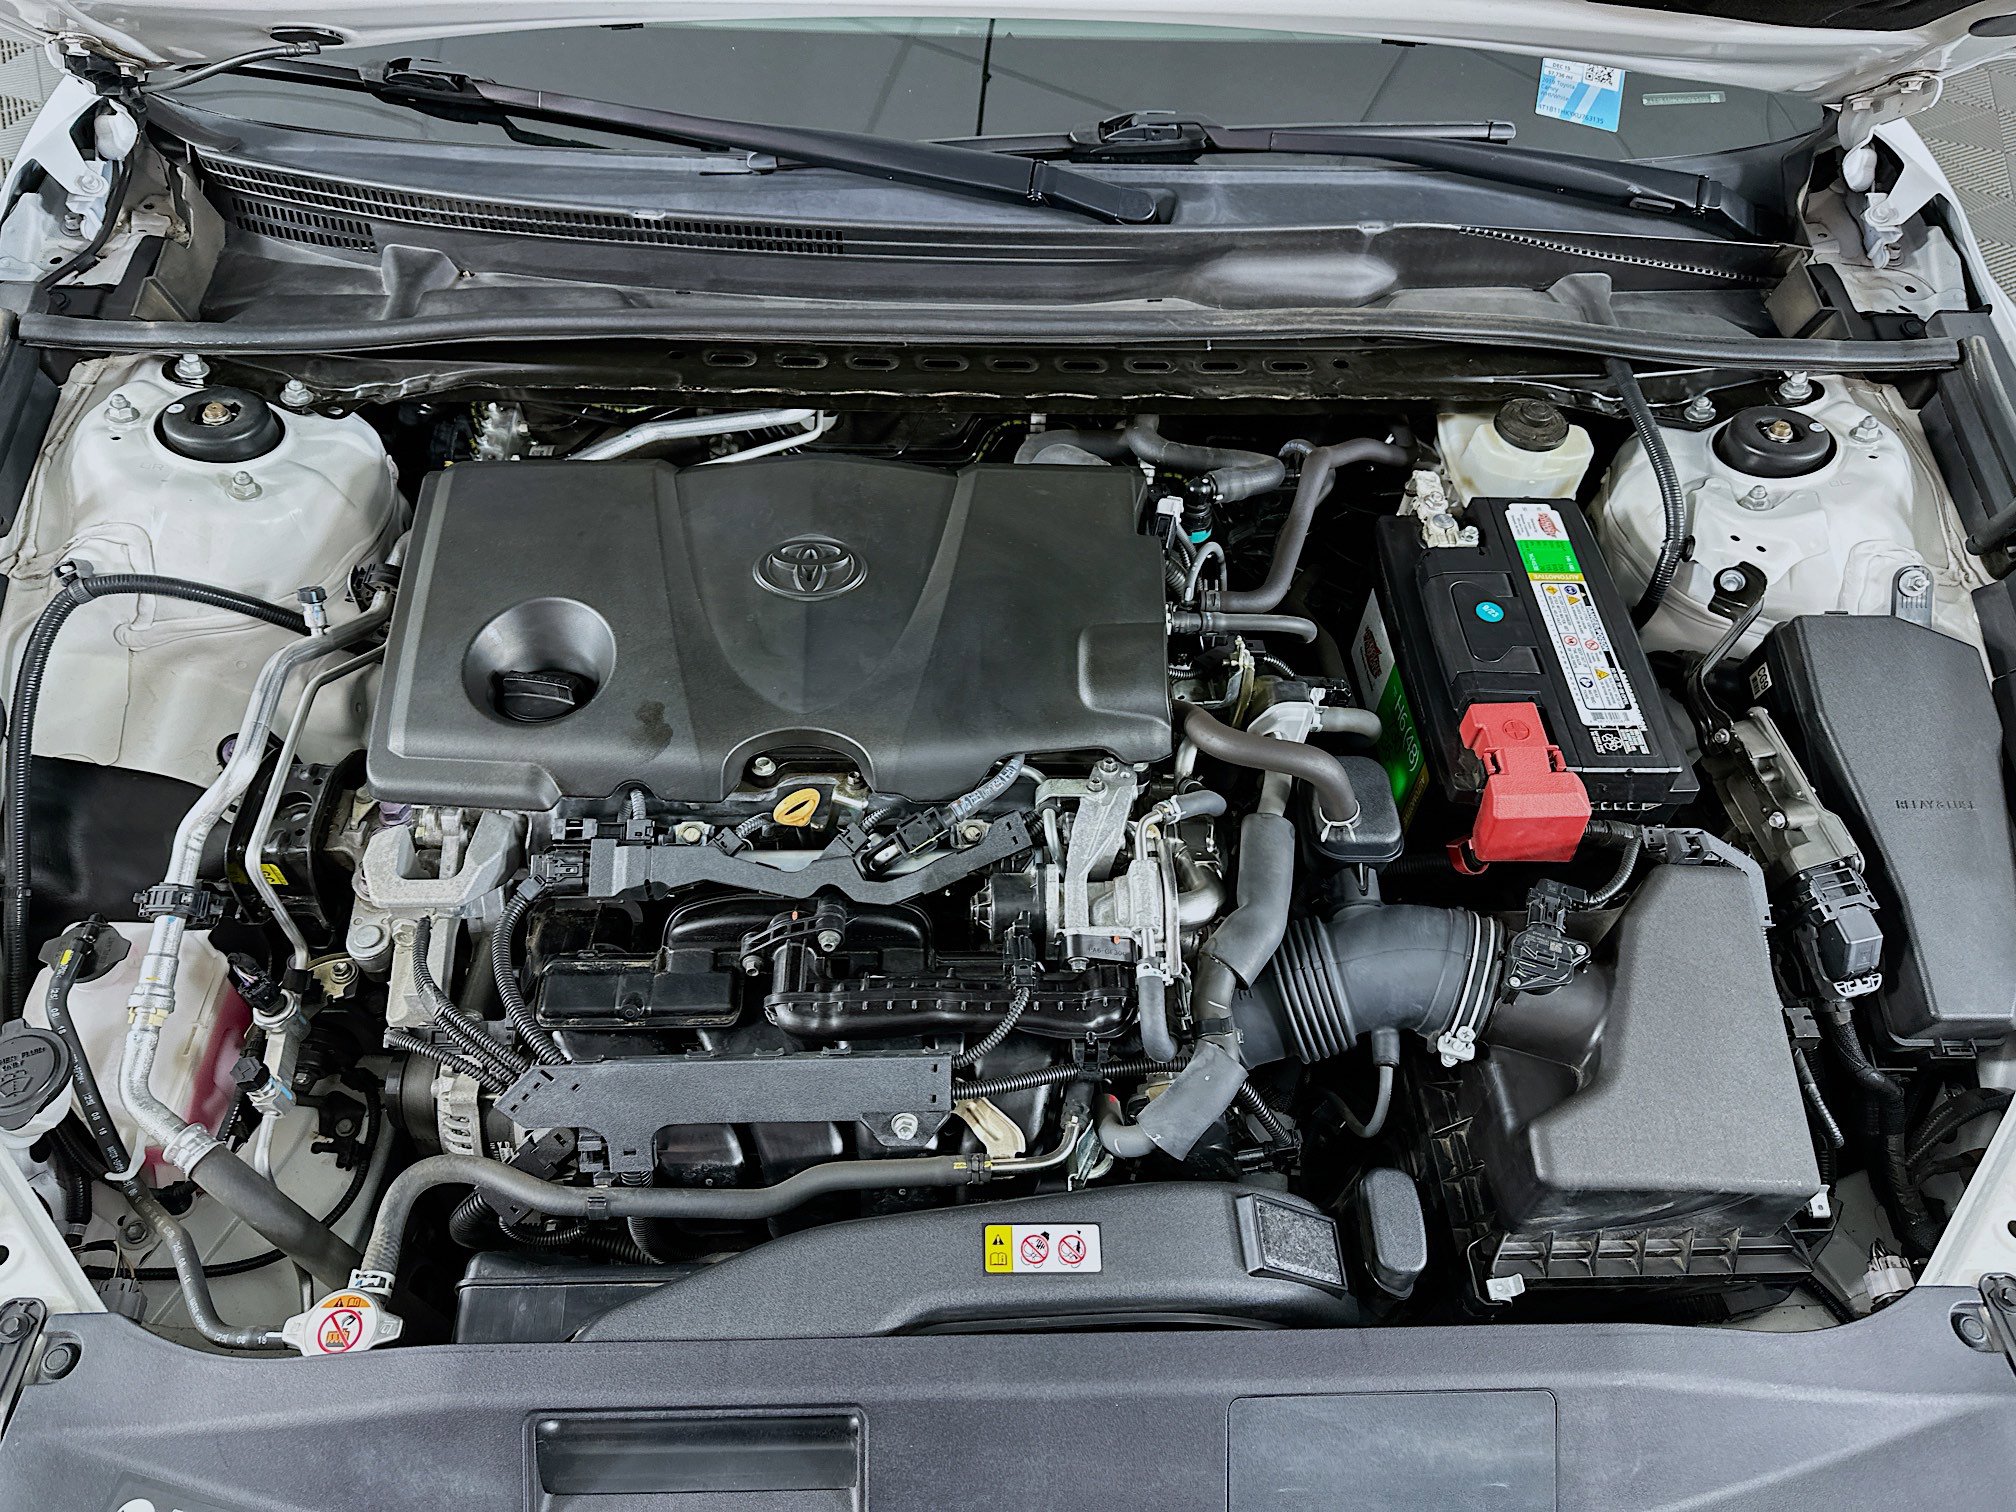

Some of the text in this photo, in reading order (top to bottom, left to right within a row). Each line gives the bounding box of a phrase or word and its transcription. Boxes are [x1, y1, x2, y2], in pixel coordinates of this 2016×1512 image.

[1552, 62, 1564, 70] DEC
[1557, 80, 1575, 90] Toyota
[1758, 666, 1769, 690] CG9
[1395, 694, 1420, 772] H6 (48)
[90, 1111, 101, 1122] 08
[98, 1127, 108, 1137] 18
